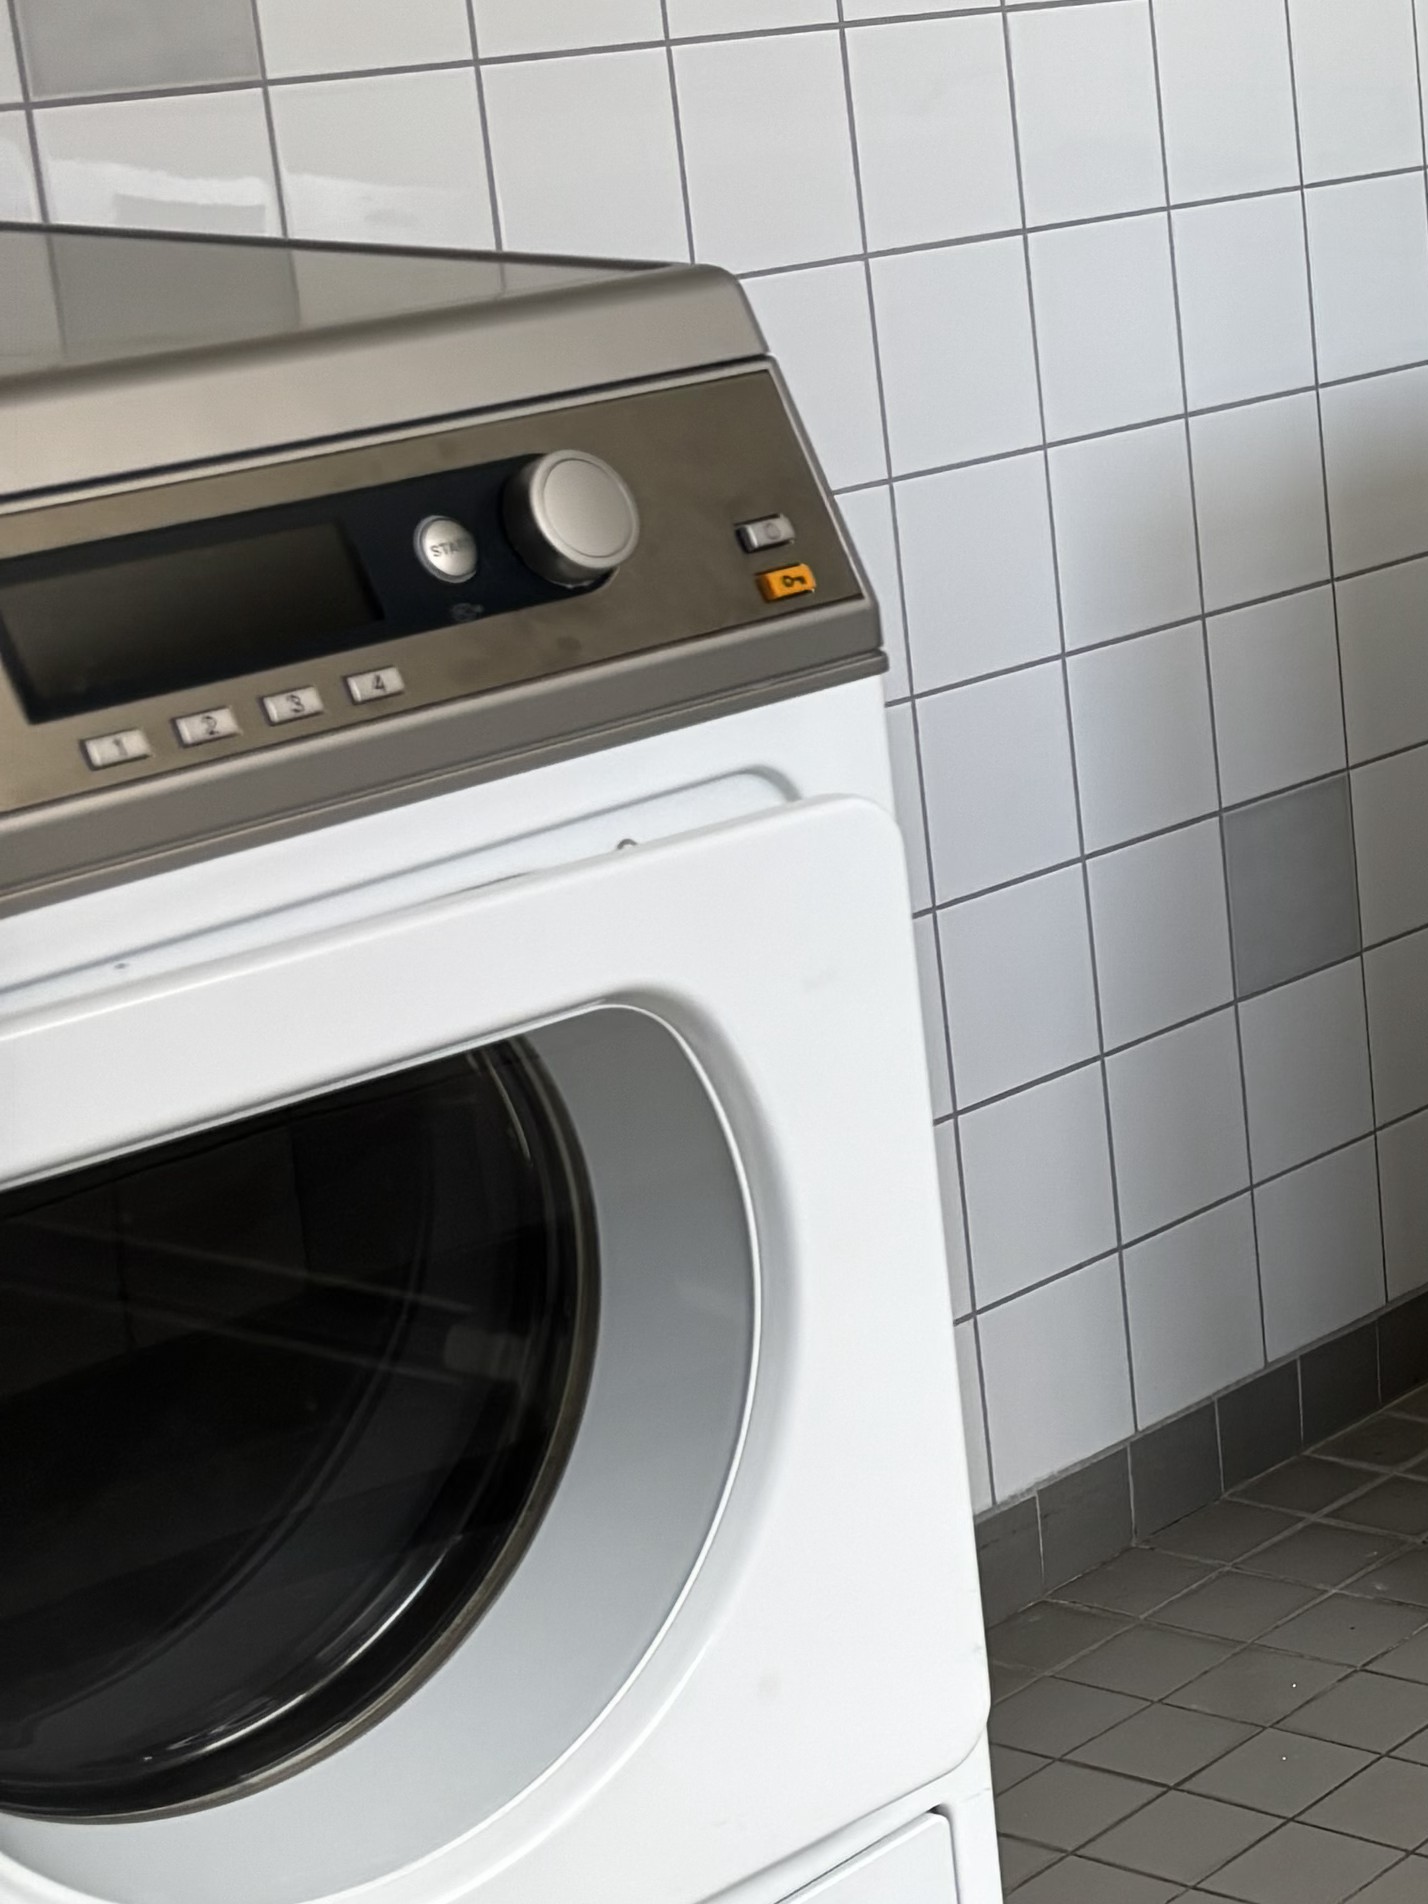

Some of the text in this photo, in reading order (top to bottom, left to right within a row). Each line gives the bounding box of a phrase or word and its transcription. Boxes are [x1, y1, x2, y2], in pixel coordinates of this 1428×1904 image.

[430, 540, 472, 558] STA
[372, 674, 387, 694] 4
[286, 693, 305, 714] 3
[202, 715, 218, 736] 2
[114, 738, 128, 757] 1
